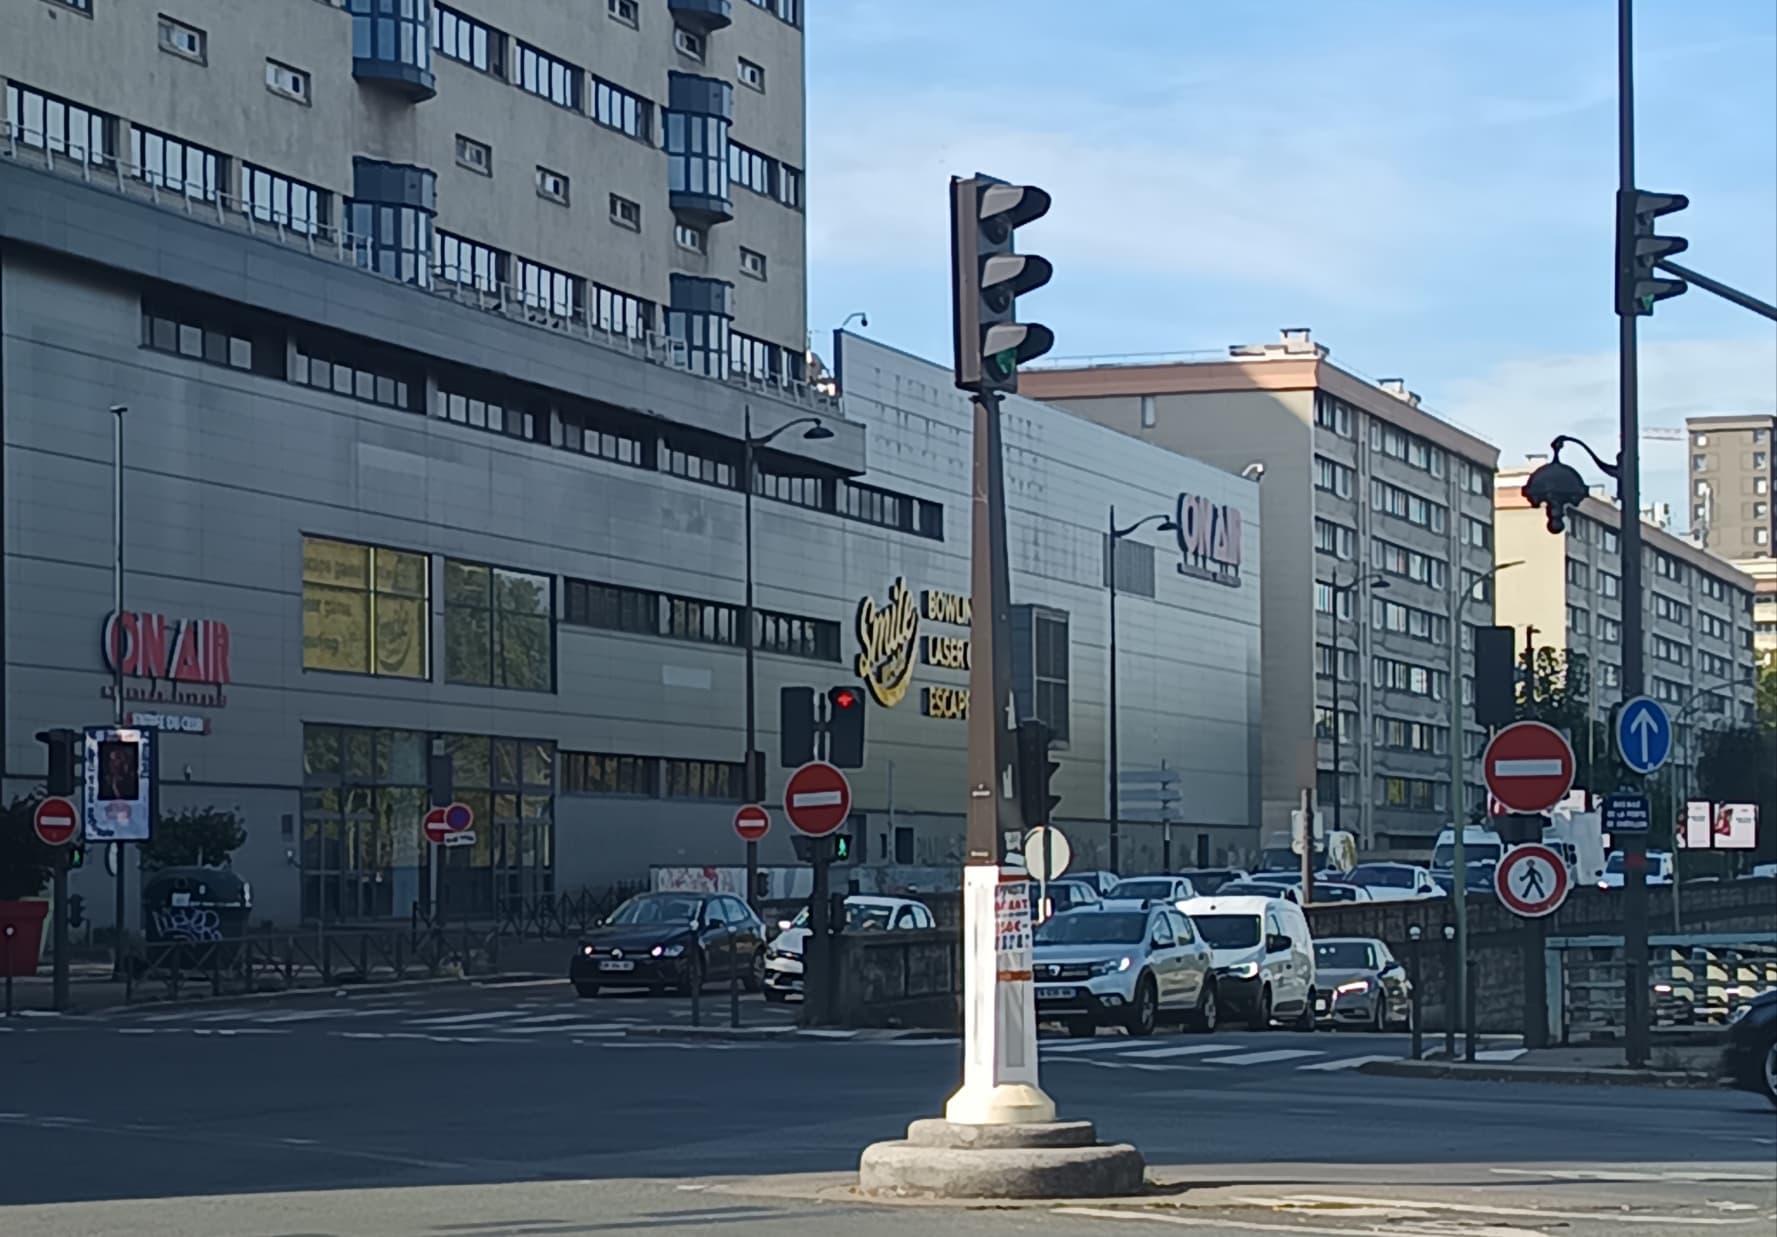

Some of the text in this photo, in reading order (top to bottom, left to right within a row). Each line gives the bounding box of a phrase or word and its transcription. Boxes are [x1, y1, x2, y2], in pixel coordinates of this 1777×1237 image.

[856, 576, 918, 678] Smile
[921, 589, 972, 626] BOWLIN
[168, 617, 231, 684] AIR
[921, 634, 965, 669] LASER
